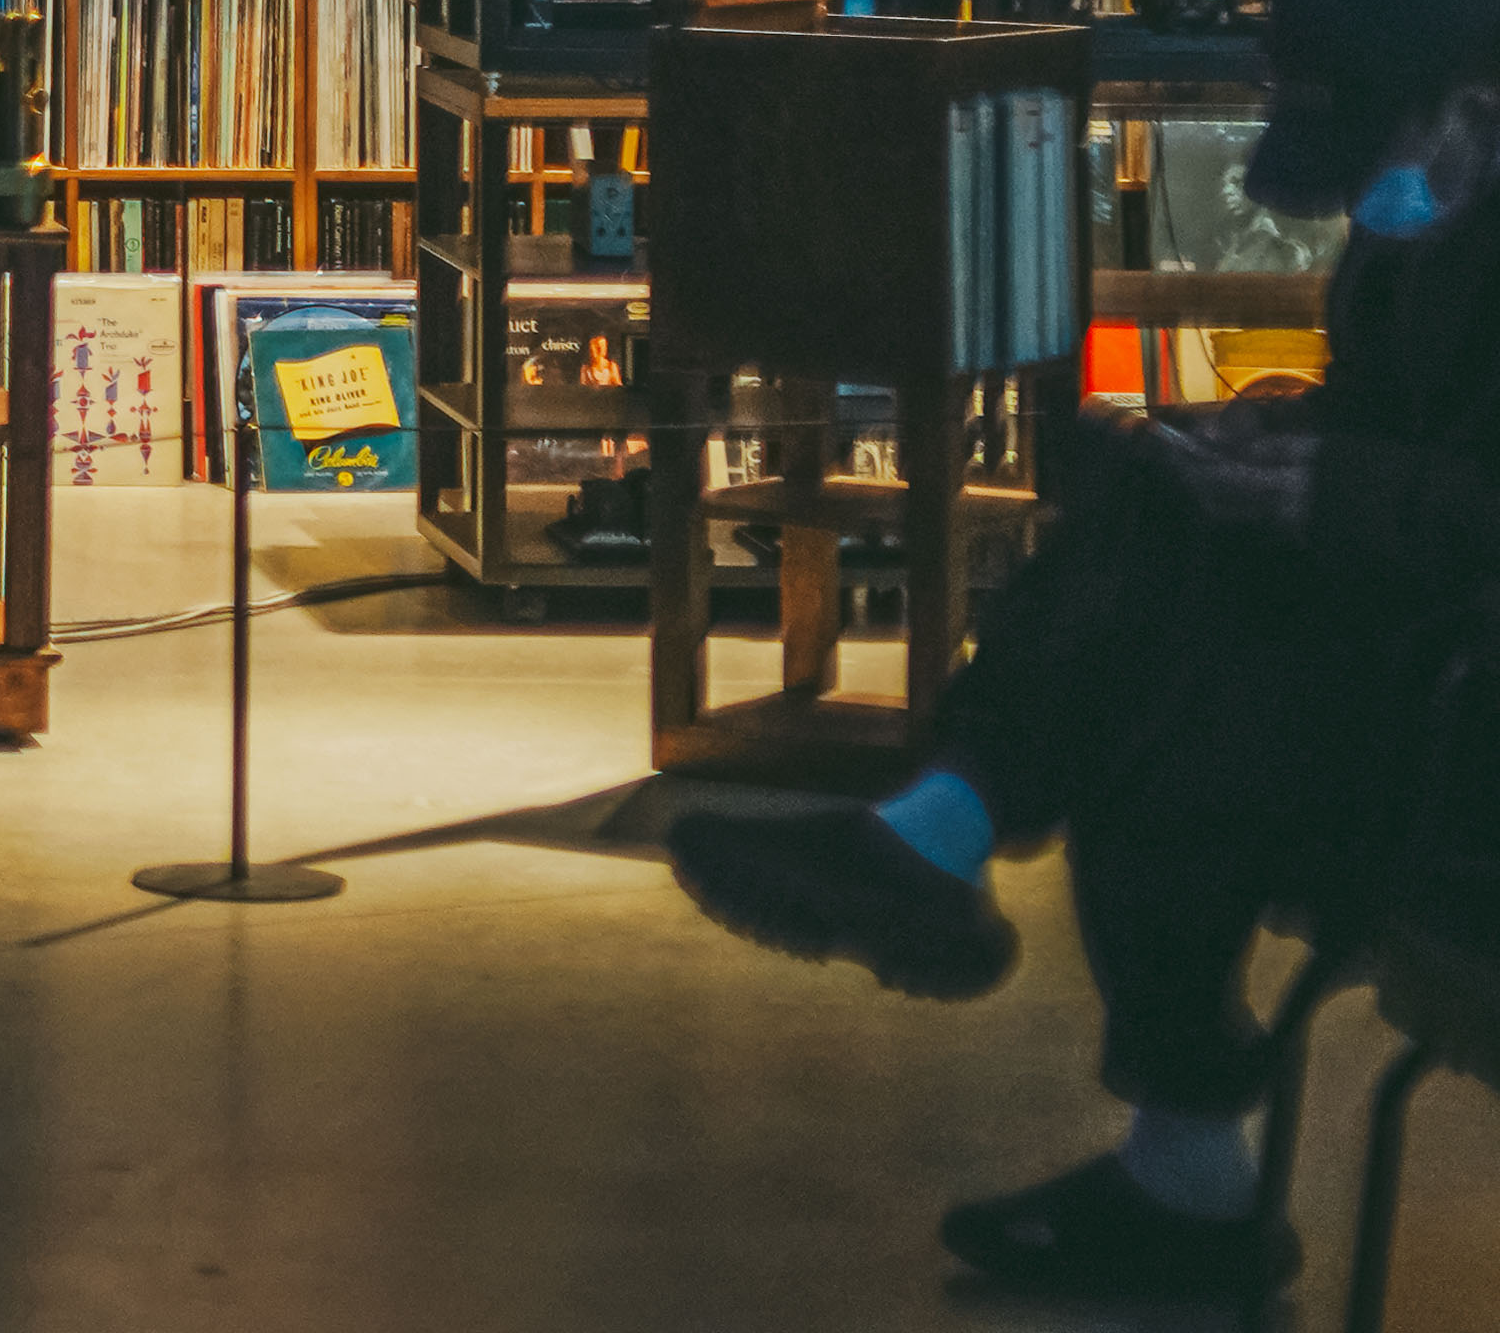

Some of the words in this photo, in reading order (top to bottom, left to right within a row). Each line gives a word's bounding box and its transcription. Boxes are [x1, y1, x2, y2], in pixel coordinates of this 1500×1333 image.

[309, 394, 332, 407] KING
[336, 388, 367, 402] OLIVER
[307, 444, 380, 471] Columbia
